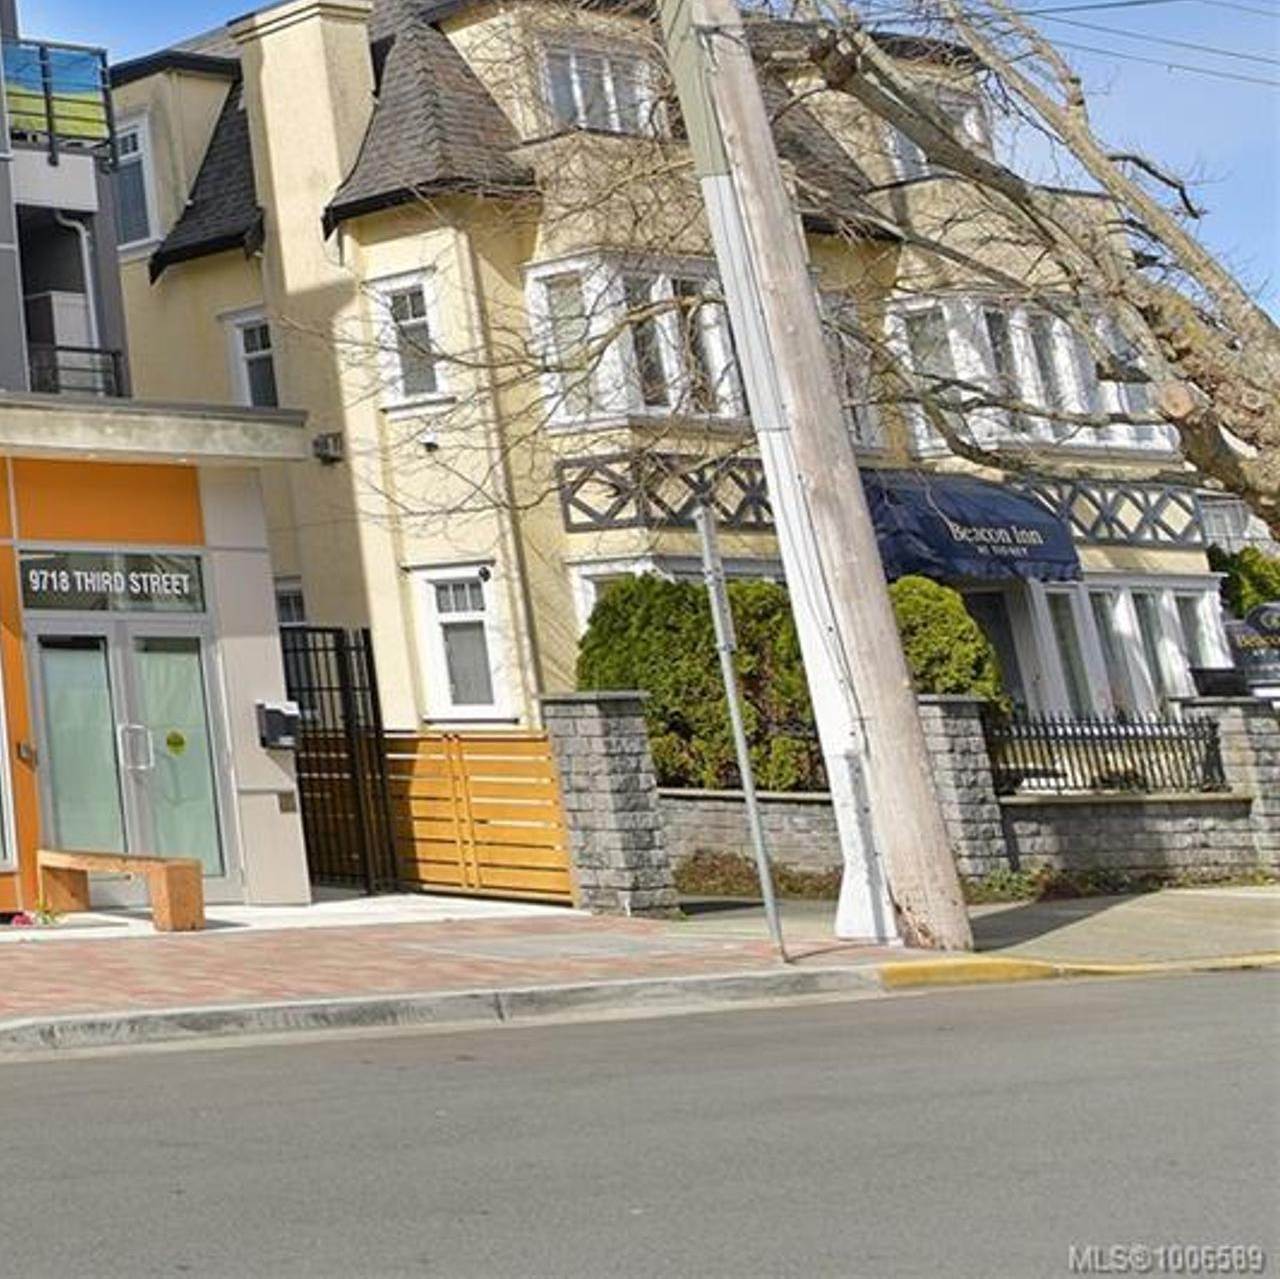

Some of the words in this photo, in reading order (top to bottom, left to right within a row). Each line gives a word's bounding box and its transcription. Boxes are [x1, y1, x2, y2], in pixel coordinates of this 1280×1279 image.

[950, 524, 1012, 544] Beacon
[1011, 525, 1044, 545] Inn
[28, 569, 70, 593] 9718
[73, 571, 126, 593] THIRD
[129, 573, 190, 595] STREET
